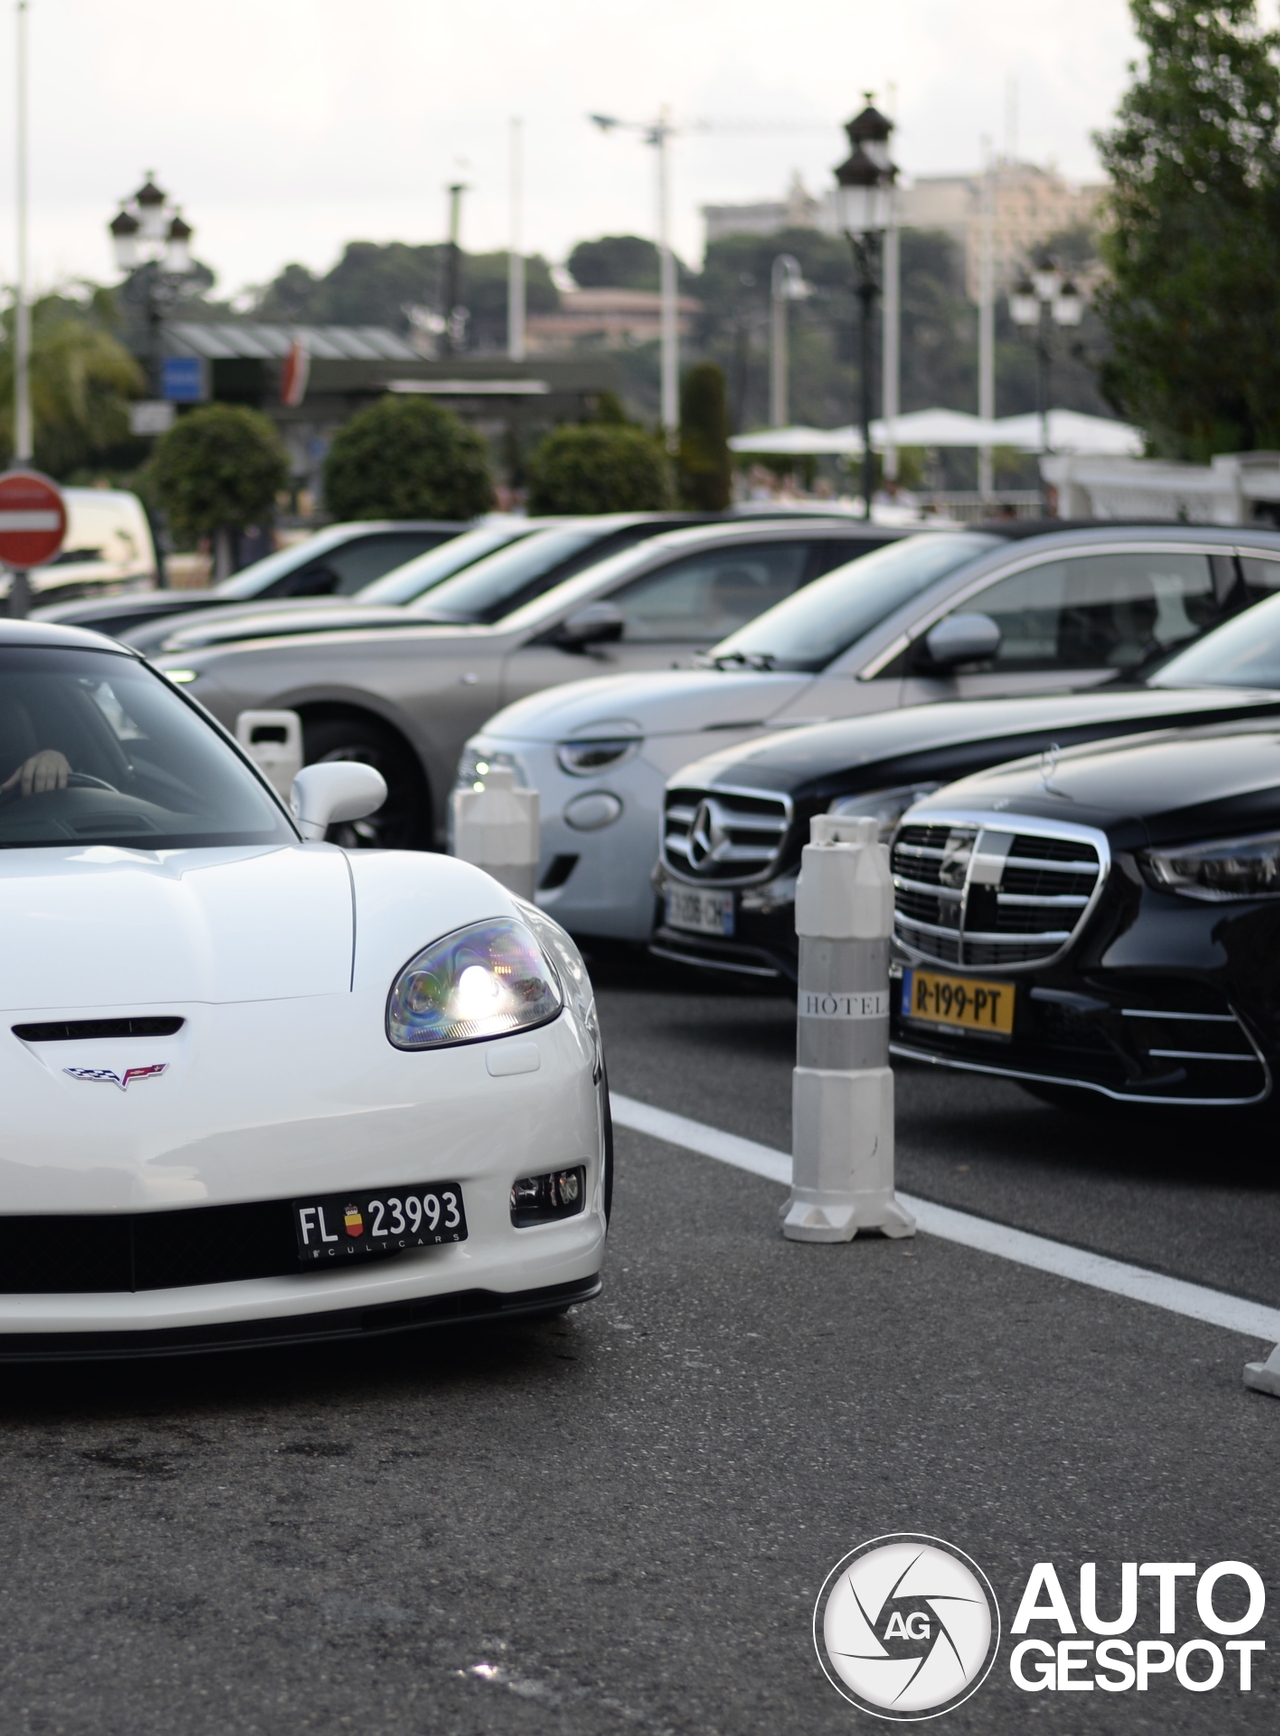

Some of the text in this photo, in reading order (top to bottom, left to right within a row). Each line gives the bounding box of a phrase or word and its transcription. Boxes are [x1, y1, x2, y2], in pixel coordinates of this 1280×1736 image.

[806, 993, 884, 1017] HÔTEL
[917, 979, 1001, 1026] R-199-PT
[299, 1191, 460, 1245] FL 23993
